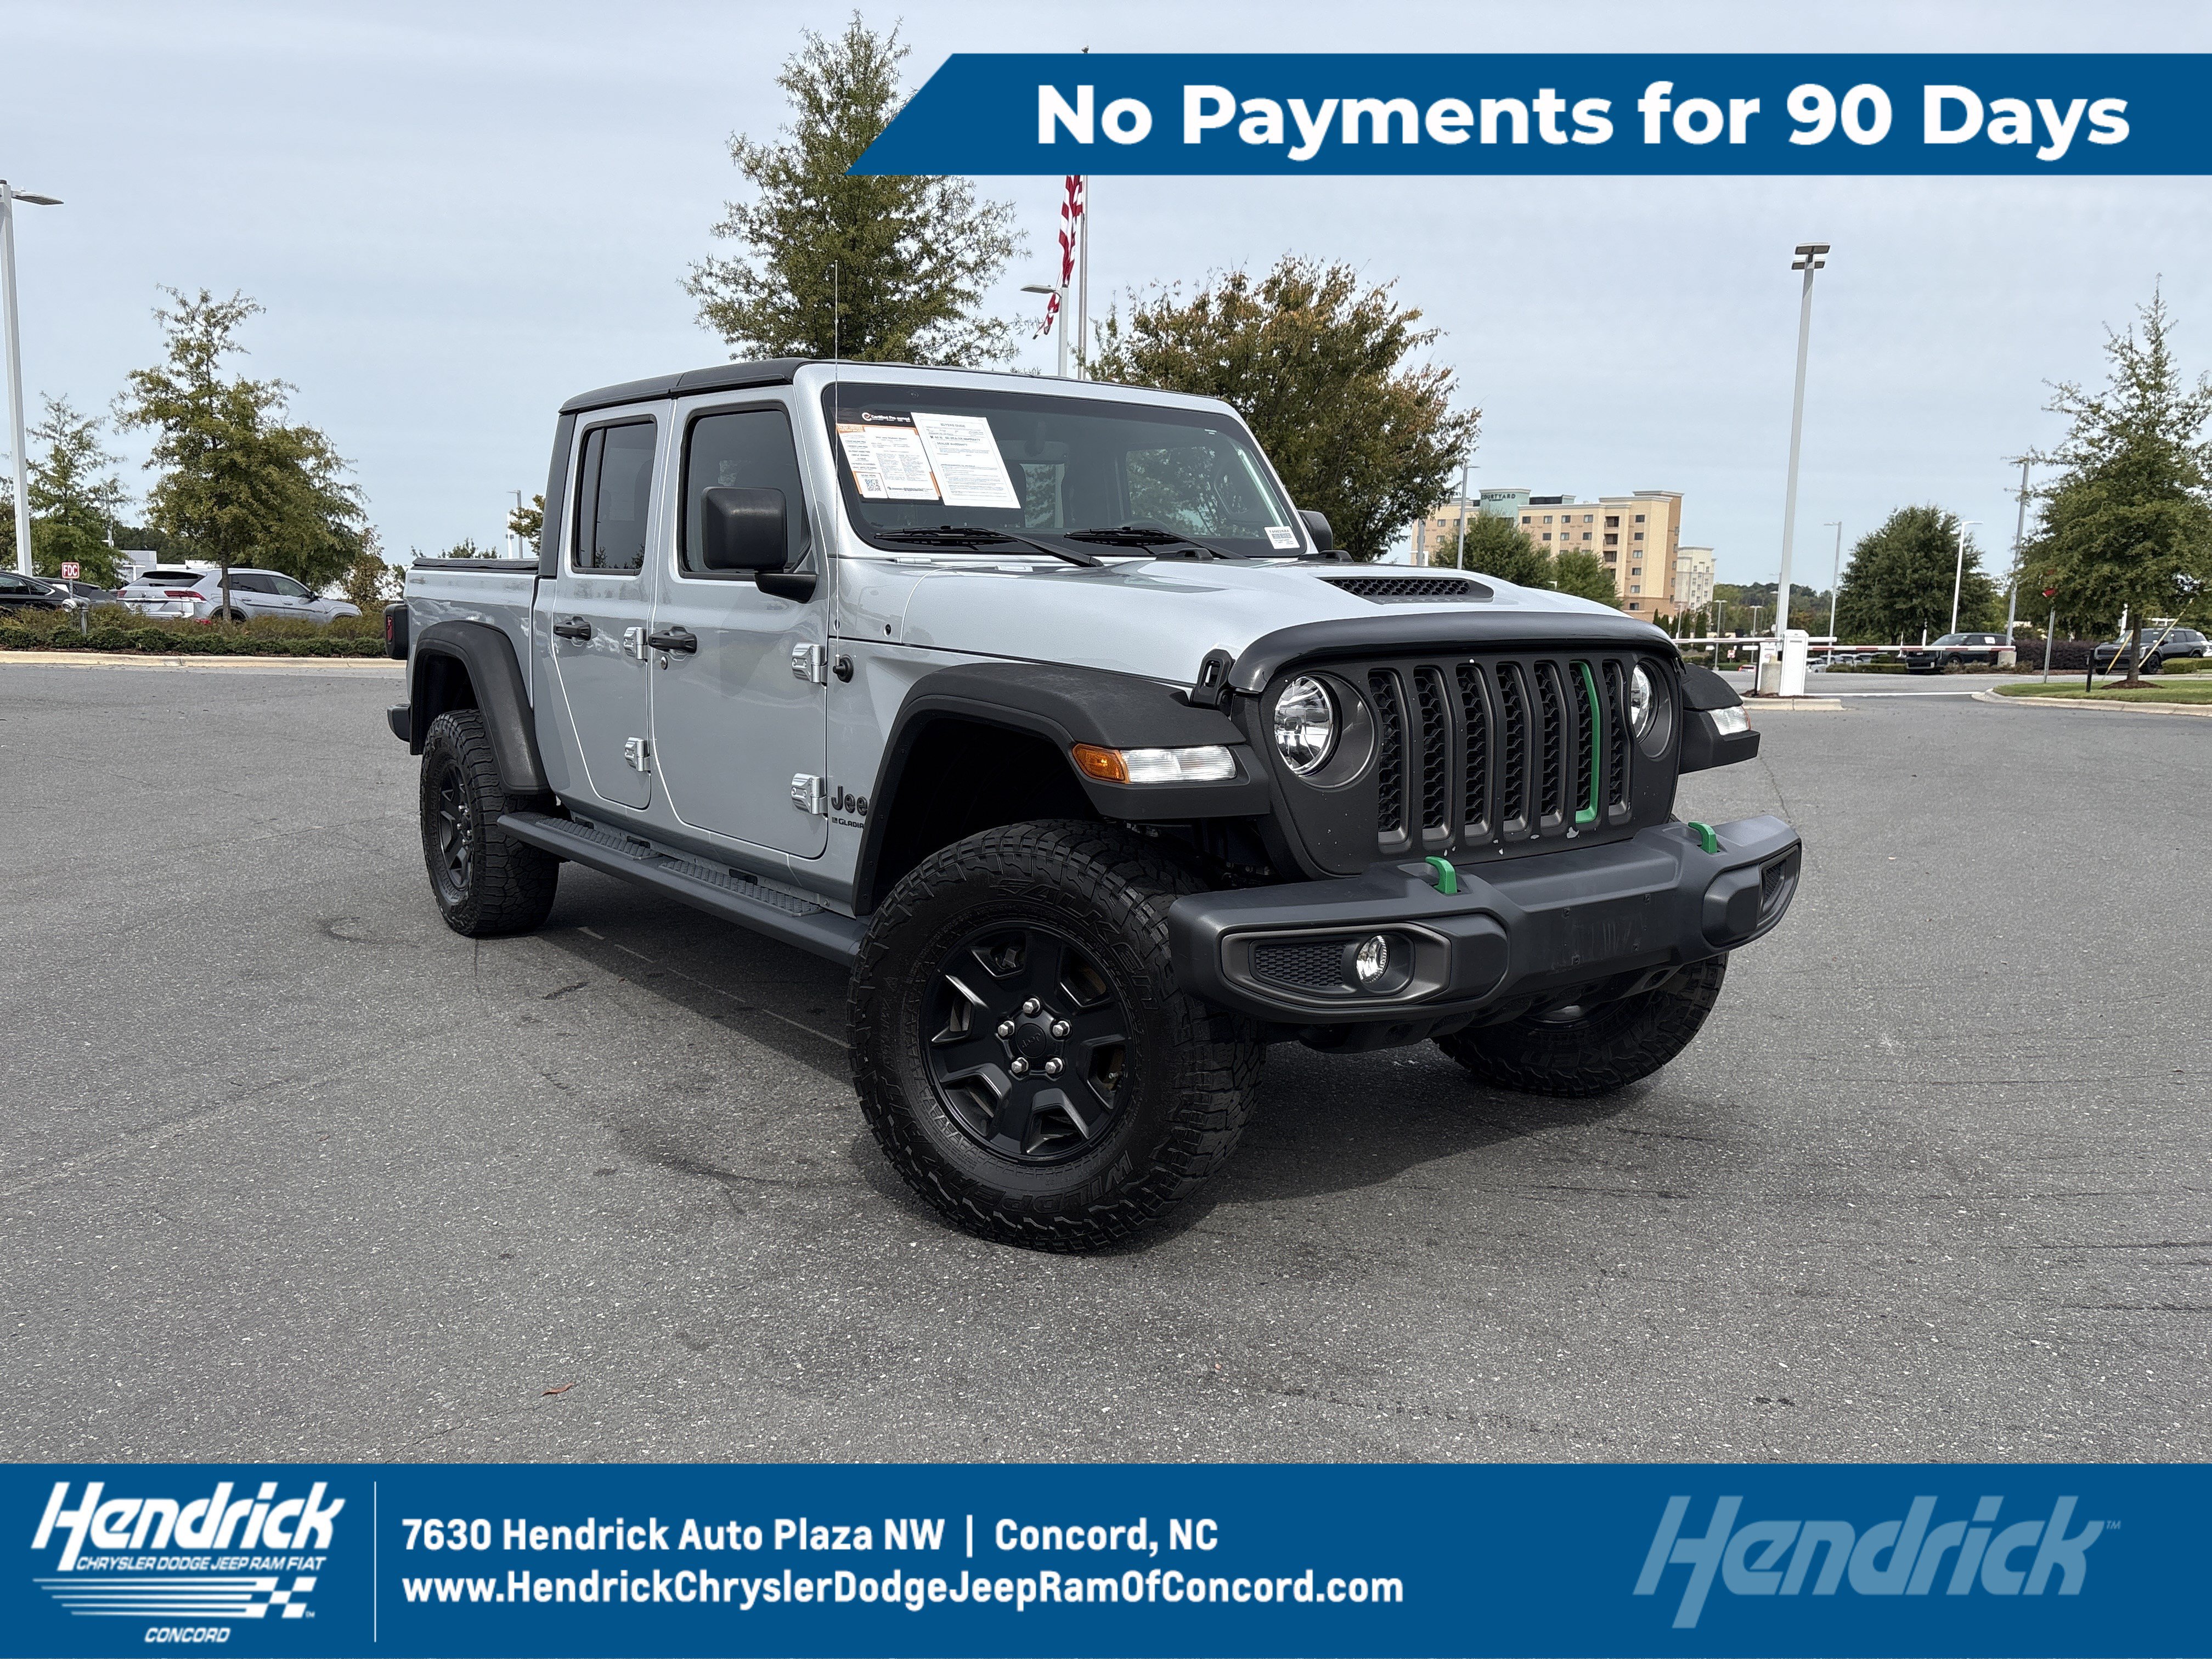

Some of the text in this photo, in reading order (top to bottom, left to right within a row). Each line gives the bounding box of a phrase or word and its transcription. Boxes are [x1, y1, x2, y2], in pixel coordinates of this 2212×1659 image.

[63, 565, 77, 576] FDC
[831, 785, 868, 816] Jee
[839, 818, 865, 830] GLADIA
